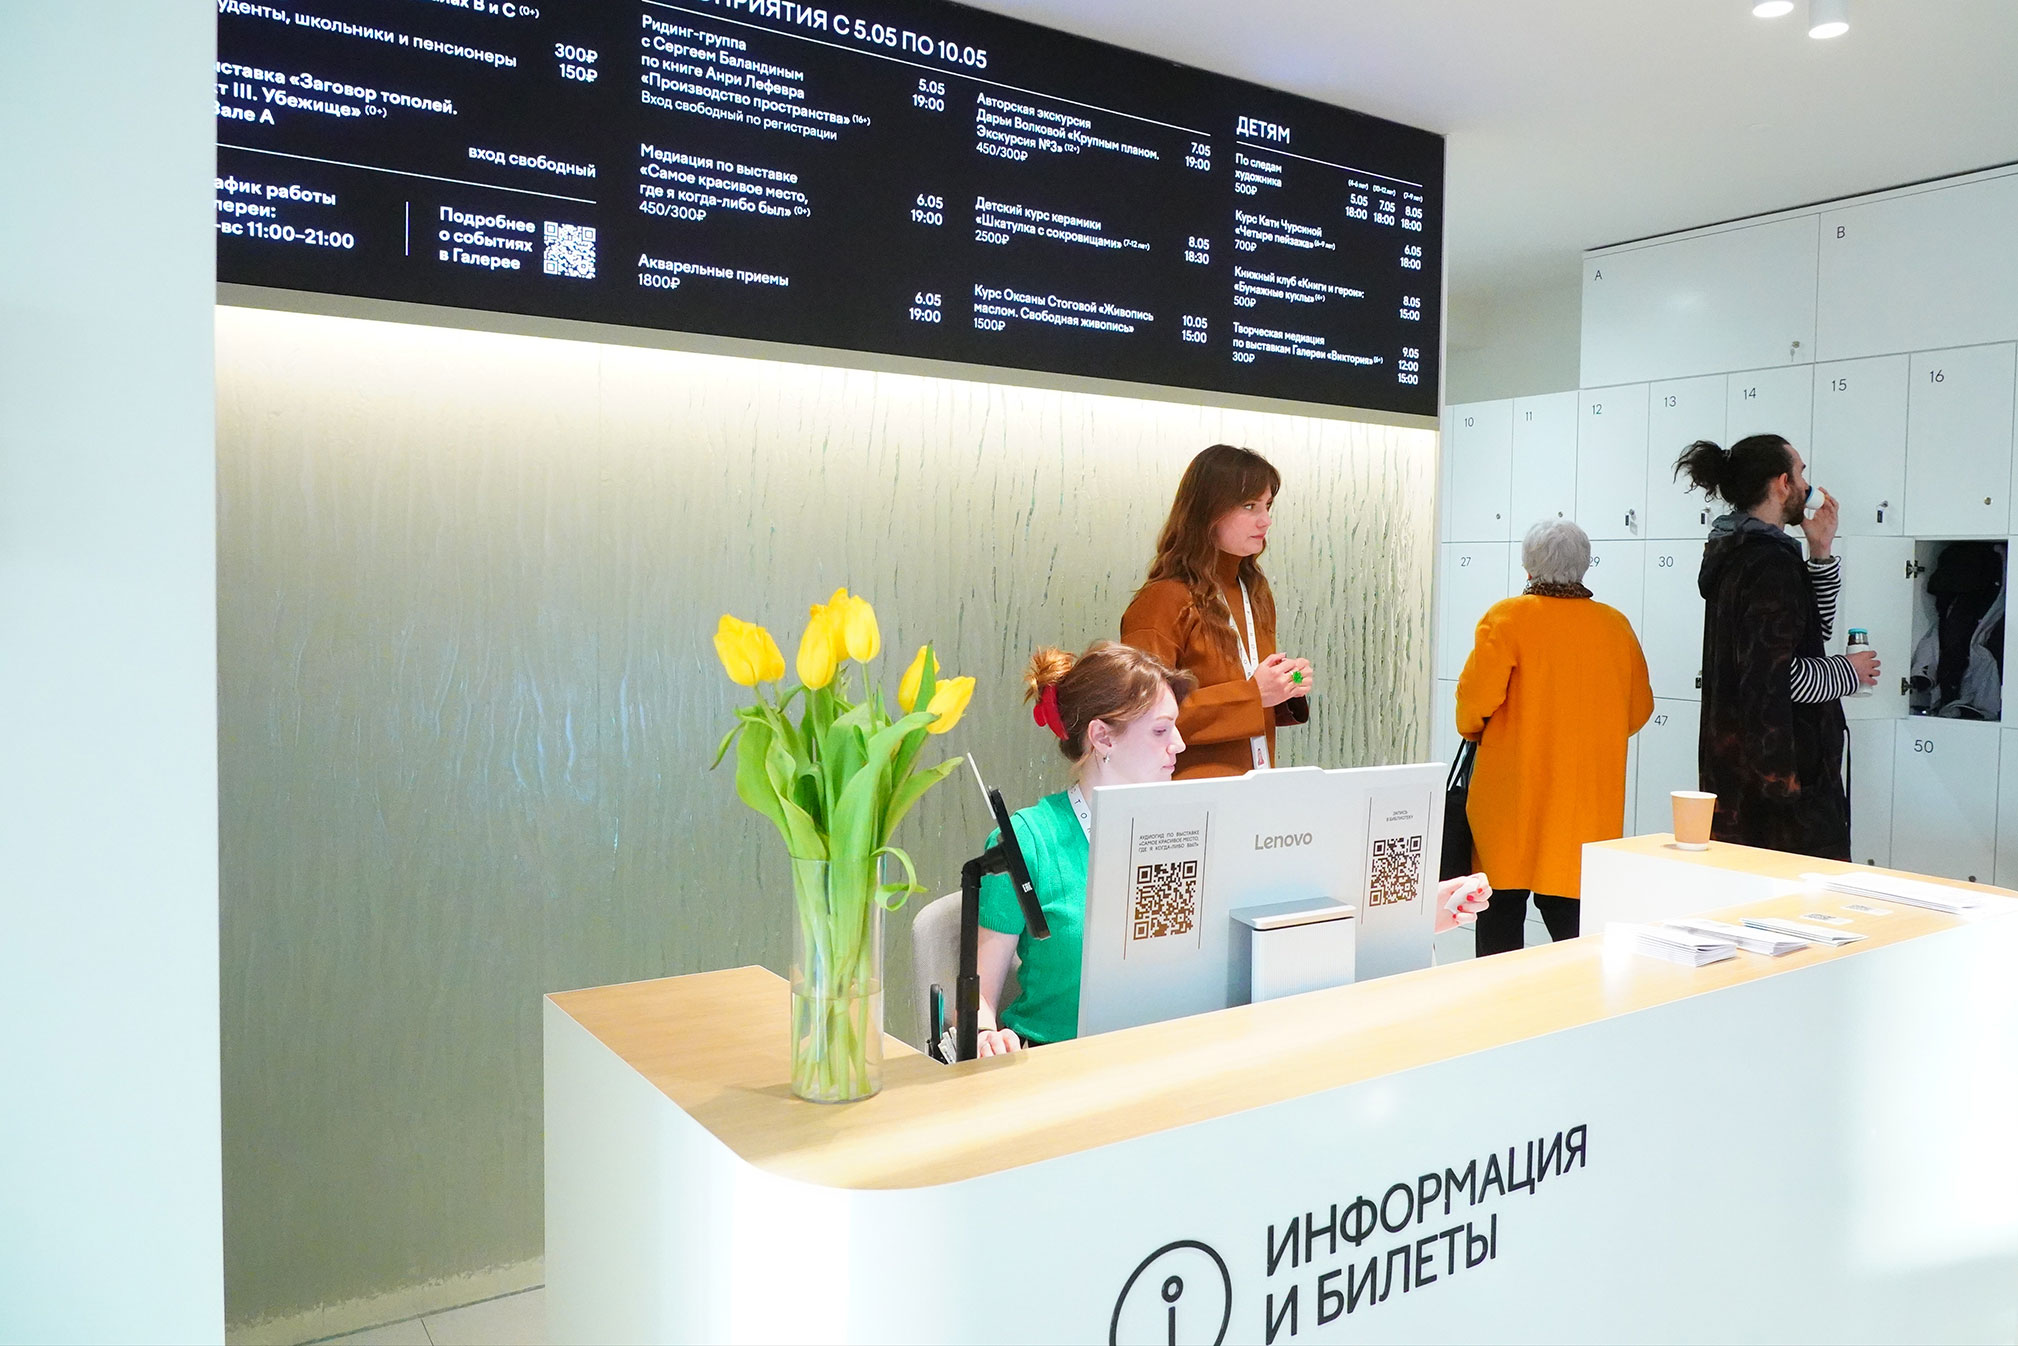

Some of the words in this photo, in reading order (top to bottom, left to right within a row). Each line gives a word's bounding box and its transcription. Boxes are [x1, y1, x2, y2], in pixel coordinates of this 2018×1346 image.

[489, 3, 498, 14] и
[502, 3, 515, 17] С
[519, 6, 539, 18] (0+)
[295, 13, 394, 43] школьники
[399, 34, 408, 46] и
[414, 37, 516, 67] пенсионеры
[643, 14, 746, 50] Ридинг-группа
[833, 15, 850, 35] С
[853, 20, 897, 46] 5.05
[902, 31, 934, 55] ПО
[938, 41, 987, 68] 10.05
[555, 43, 598, 63] 300₽
[642, 37, 650, 47] с
[653, 36, 716, 62] Сергеем
[720, 50, 803, 81] Баландиным
[560, 64, 597, 82] 150₽
[642, 56, 659, 68] по
[663, 60, 703, 77] книге
[706, 66, 742, 86] Анри
[745, 74, 804, 99] Лефевра
[290, 73, 377, 103] «Заговор
[380, 92, 457, 115] тополей.
[919, 78, 945, 95] 5.05
[234, 82, 257, 100] III.
[262, 87, 361, 117] Убежище»
[365, 105, 387, 118] (0+)
[641, 72, 750, 105] «Производство
[754, 98, 850, 124] пространства»
[913, 94, 944, 111] 19:00
[260, 109, 274, 125] А
[642, 90, 672, 110] Вход
[675, 101, 743, 122] свободный
[746, 115, 761, 125] по
[764, 119, 837, 140] регистрации
[977, 92, 1035, 116] Авторская
[1037, 109, 1091, 129] экскурсия
[976, 108, 1012, 127] Дарьи
[1015, 116, 1065, 138] Волковой
[1068, 130, 1119, 150] «Крупным
[1121, 144, 1159, 160] планом.
[977, 125, 1036, 148] Экскурсия
[1039, 138, 1062, 152] №3»
[1191, 142, 1210, 156] 7.05
[469, 148, 506, 165] вход
[509, 154, 595, 178] свободный
[641, 144, 713, 169] Медиация
[717, 161, 734, 172] по
[737, 164, 798, 183] выставке
[1185, 156, 1210, 171] 19:00
[640, 164, 695, 184] «Самое
[699, 176, 763, 195] красивое
[766, 187, 808, 205] место,
[266, 185, 335, 205] работы
[640, 184, 664, 198] где
[667, 189, 674, 198] я
[678, 191, 756, 212] когда-либо
[758, 201, 791, 216] был»
[794, 206, 810, 217] (0+)
[917, 194, 943, 209] 6.05
[440, 206, 535, 233] Подробнее
[911, 209, 942, 225] 19:00
[975, 196, 1022, 216] Детский
[1025, 209, 1050, 222] курс
[1052, 214, 1101, 230] керамики
[439, 230, 450, 240] о
[454, 231, 532, 252] событиях
[975, 214, 1036, 234] «Шкатулка
[1038, 227, 1044, 235] с
[1046, 228, 1122, 248] сокровищами»
[1189, 236, 1209, 250] 8.05
[440, 250, 449, 261] в
[453, 248, 520, 270] Галерее
[1185, 250, 1209, 264] 18:30
[638, 254, 734, 278] Акварельные
[737, 270, 788, 286] приемы
[915, 292, 941, 306] 6.05
[975, 284, 1002, 300] Курс
[1004, 289, 1045, 305] Оксаны
[1048, 295, 1096, 313] Стоговой
[1098, 303, 1154, 321] «Живопись
[909, 308, 941, 323] 19:00
[974, 304, 1018, 317] маслом.
[1020, 307, 1079, 326] Свободная
[1081, 318, 1134, 332] живопись»
[1183, 315, 1207, 328] 10.05
[1182, 330, 1207, 343] 15:00
[1832, 379, 1846, 391] 15
[1930, 370, 1944, 382] 16
[1665, 396, 1676, 407] 13
[1744, 388, 1756, 400] 14
[1526, 412, 1532, 421] 11
[1592, 404, 1602, 414] 12
[1465, 417, 1474, 427] 10
[1461, 557, 1471, 567] 27
[1659, 556, 1673, 567] 30
[1654, 714, 1668, 726] 47
[1914, 740, 1933, 753] 50
[1255, 833, 1312, 850] Lenovo
[1267, 1123, 1588, 1277] ИНФОРМАЦИЯ
[1266, 1284, 1298, 1346] И
[1318, 1213, 1497, 1326] БИЛЕТЫ
